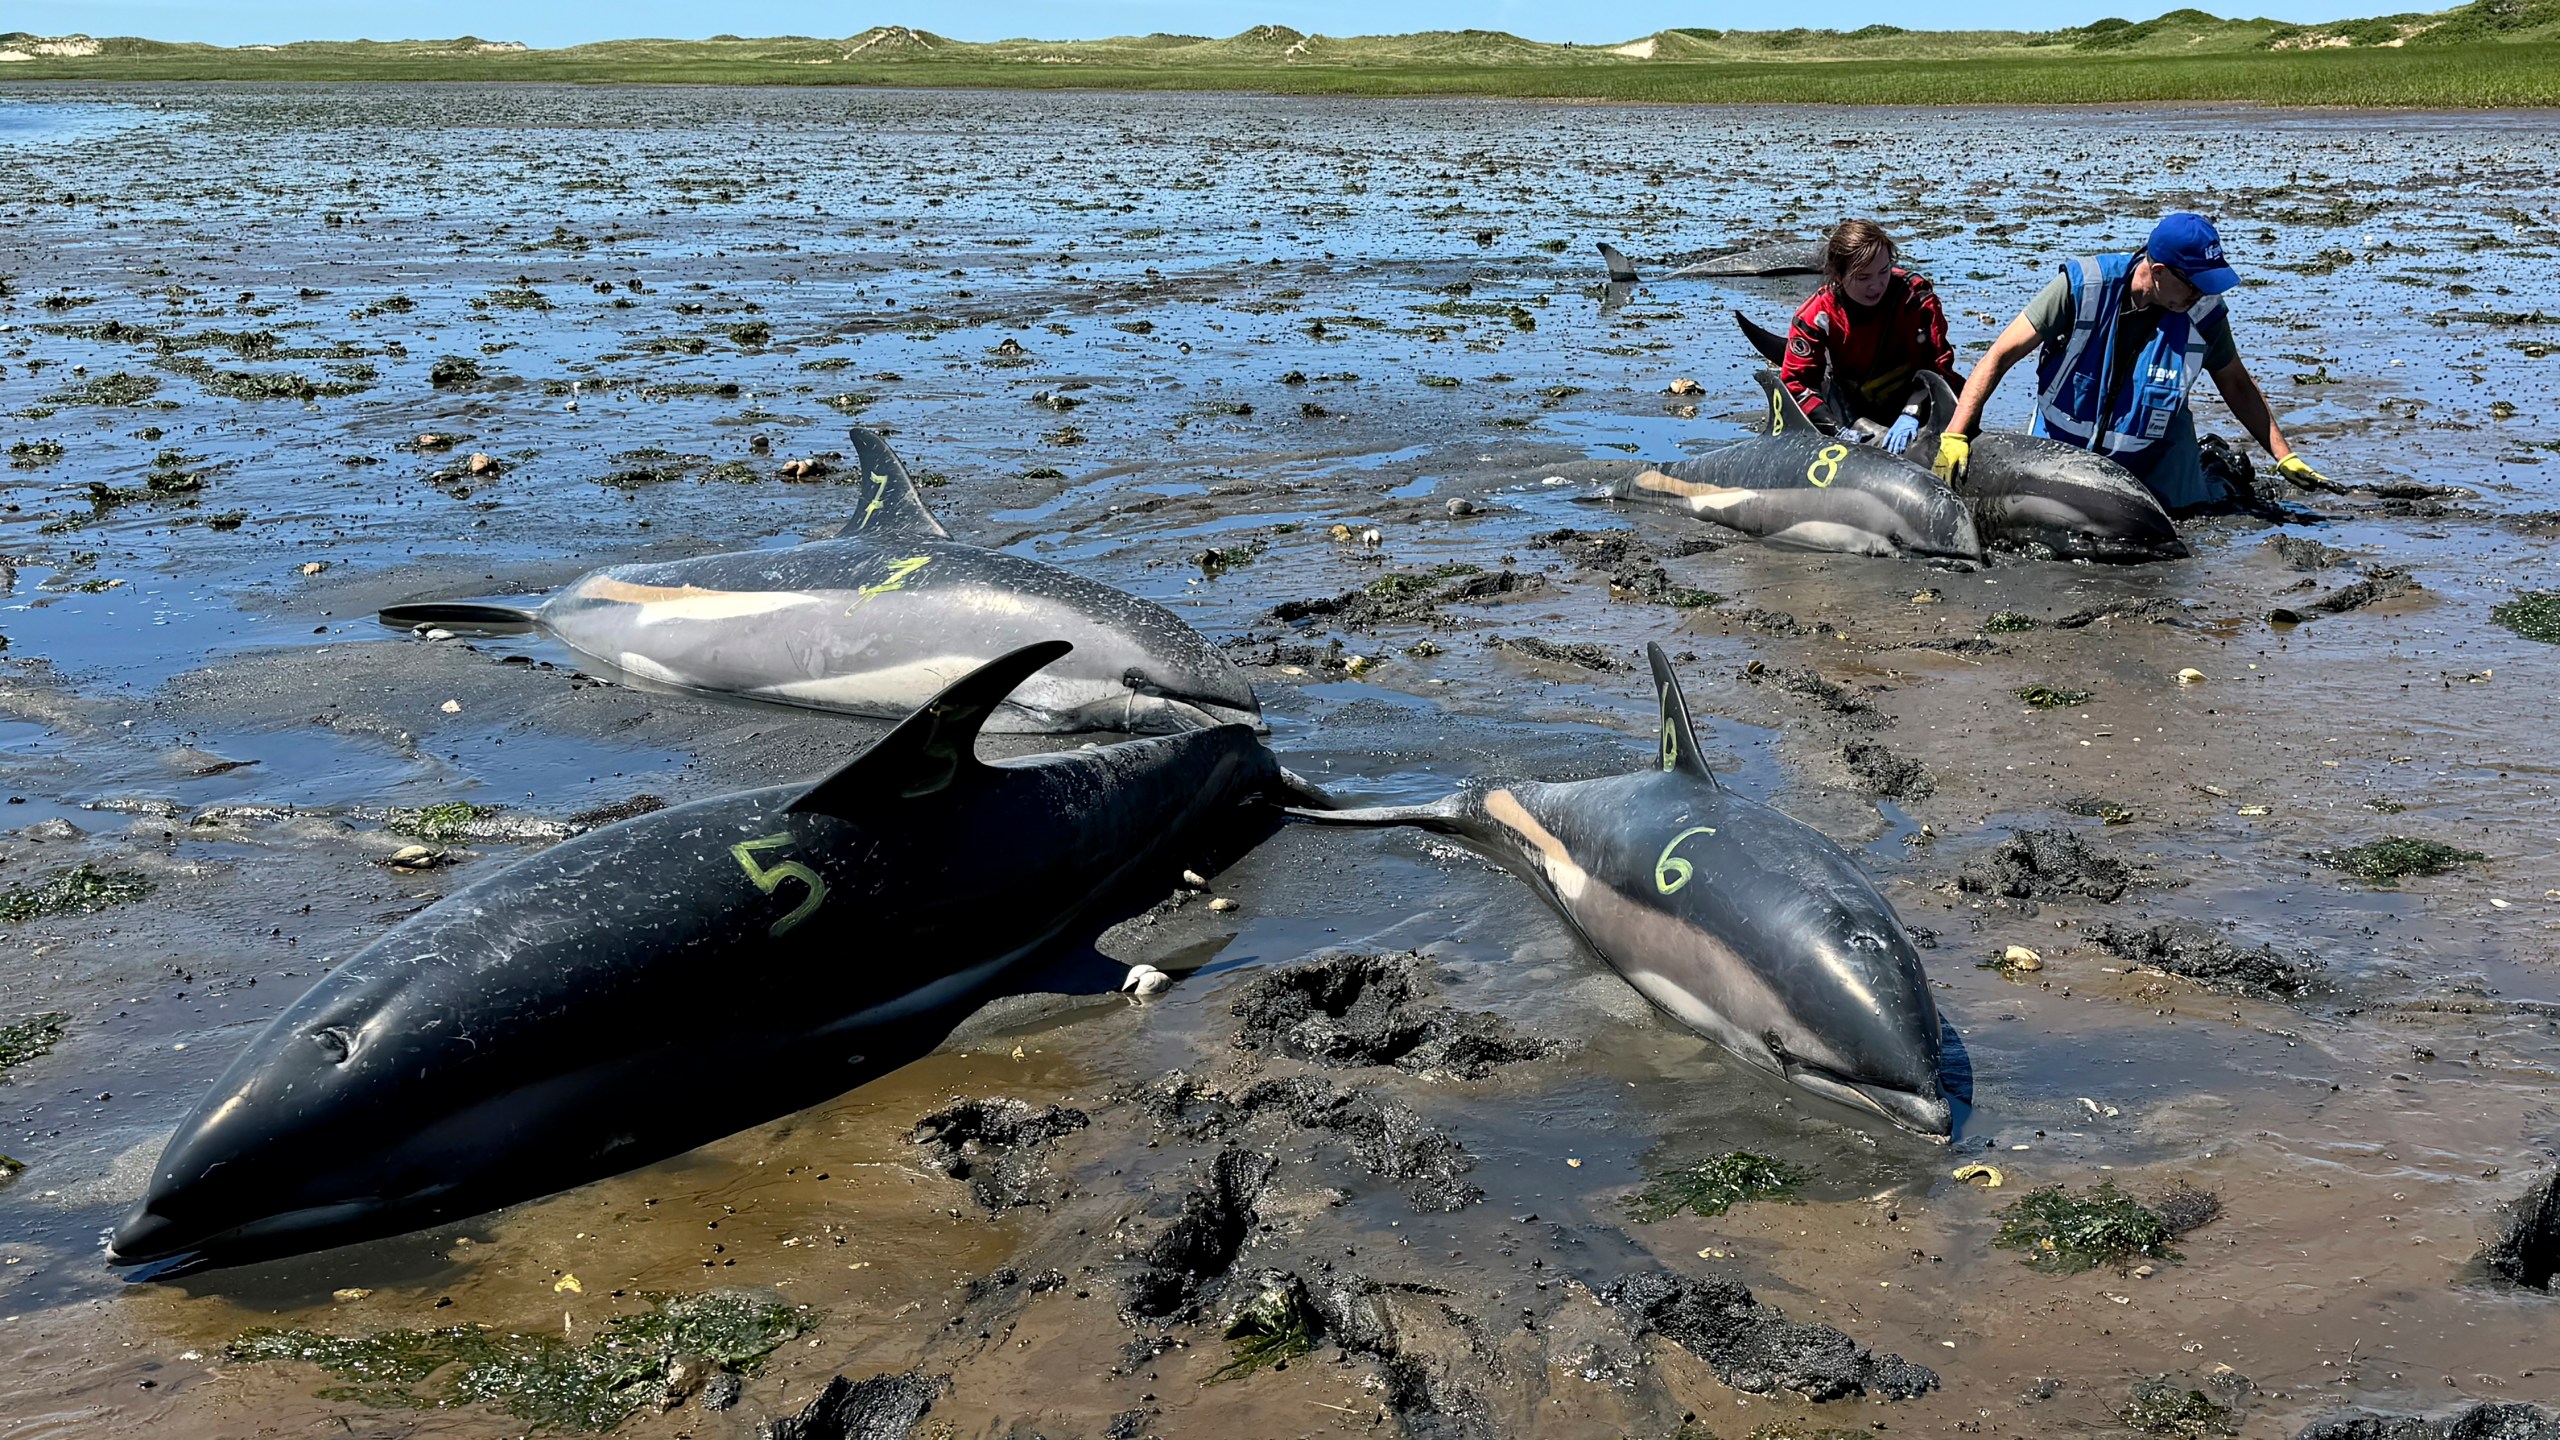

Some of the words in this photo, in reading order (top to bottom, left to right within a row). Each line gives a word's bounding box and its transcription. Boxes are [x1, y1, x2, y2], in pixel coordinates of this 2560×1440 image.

[2147, 364, 2178, 382] ifaw
[1772, 388, 1784, 437] 8
[1807, 444, 1848, 488] 8
[857, 471, 889, 530] 7
[1662, 681, 1677, 773] 6
[730, 831, 826, 938] 5
[1655, 826, 1717, 895] 6
